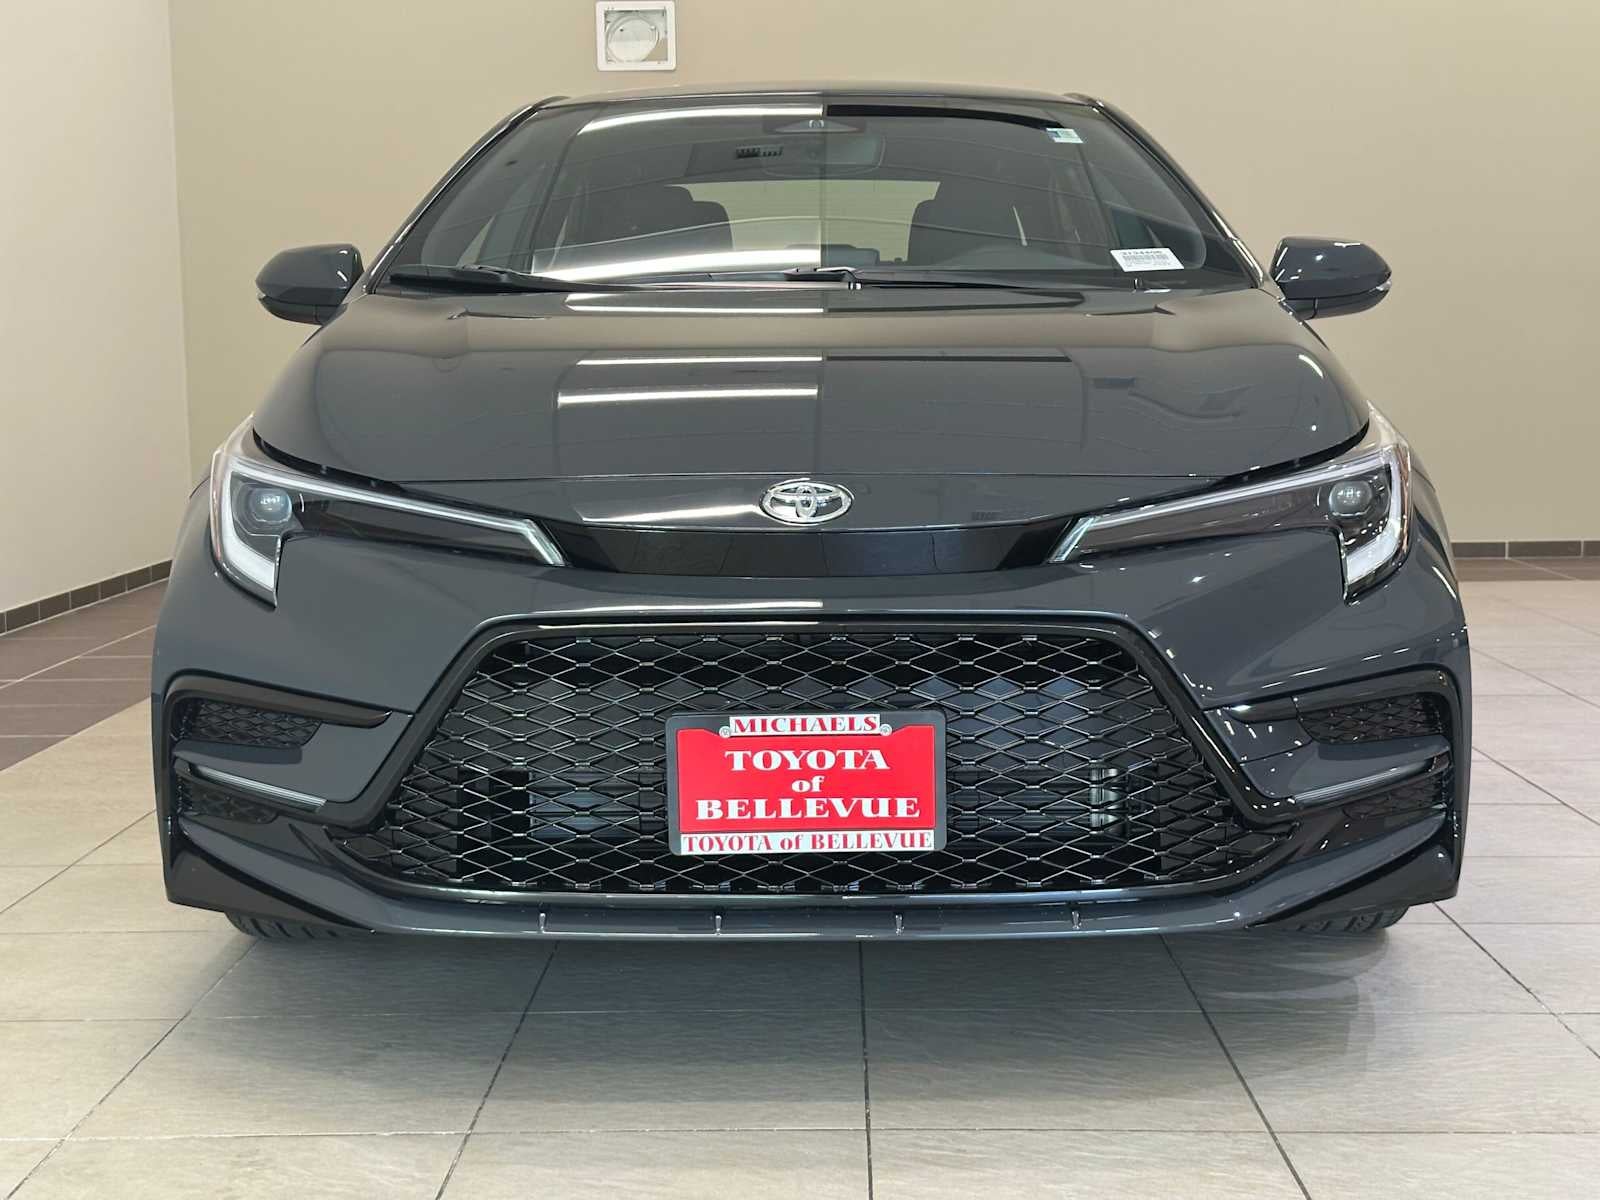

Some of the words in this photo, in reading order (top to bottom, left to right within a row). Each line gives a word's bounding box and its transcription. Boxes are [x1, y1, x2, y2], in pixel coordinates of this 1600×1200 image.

[733, 716, 878, 734] MICHAELS
[725, 749, 890, 772] TOYOTA
[791, 775, 825, 793] of
[695, 797, 920, 821] BELLEVUE
[683, 834, 775, 853] TOYOTA
[780, 833, 804, 850] of
[810, 831, 932, 850] BELLEVUE
